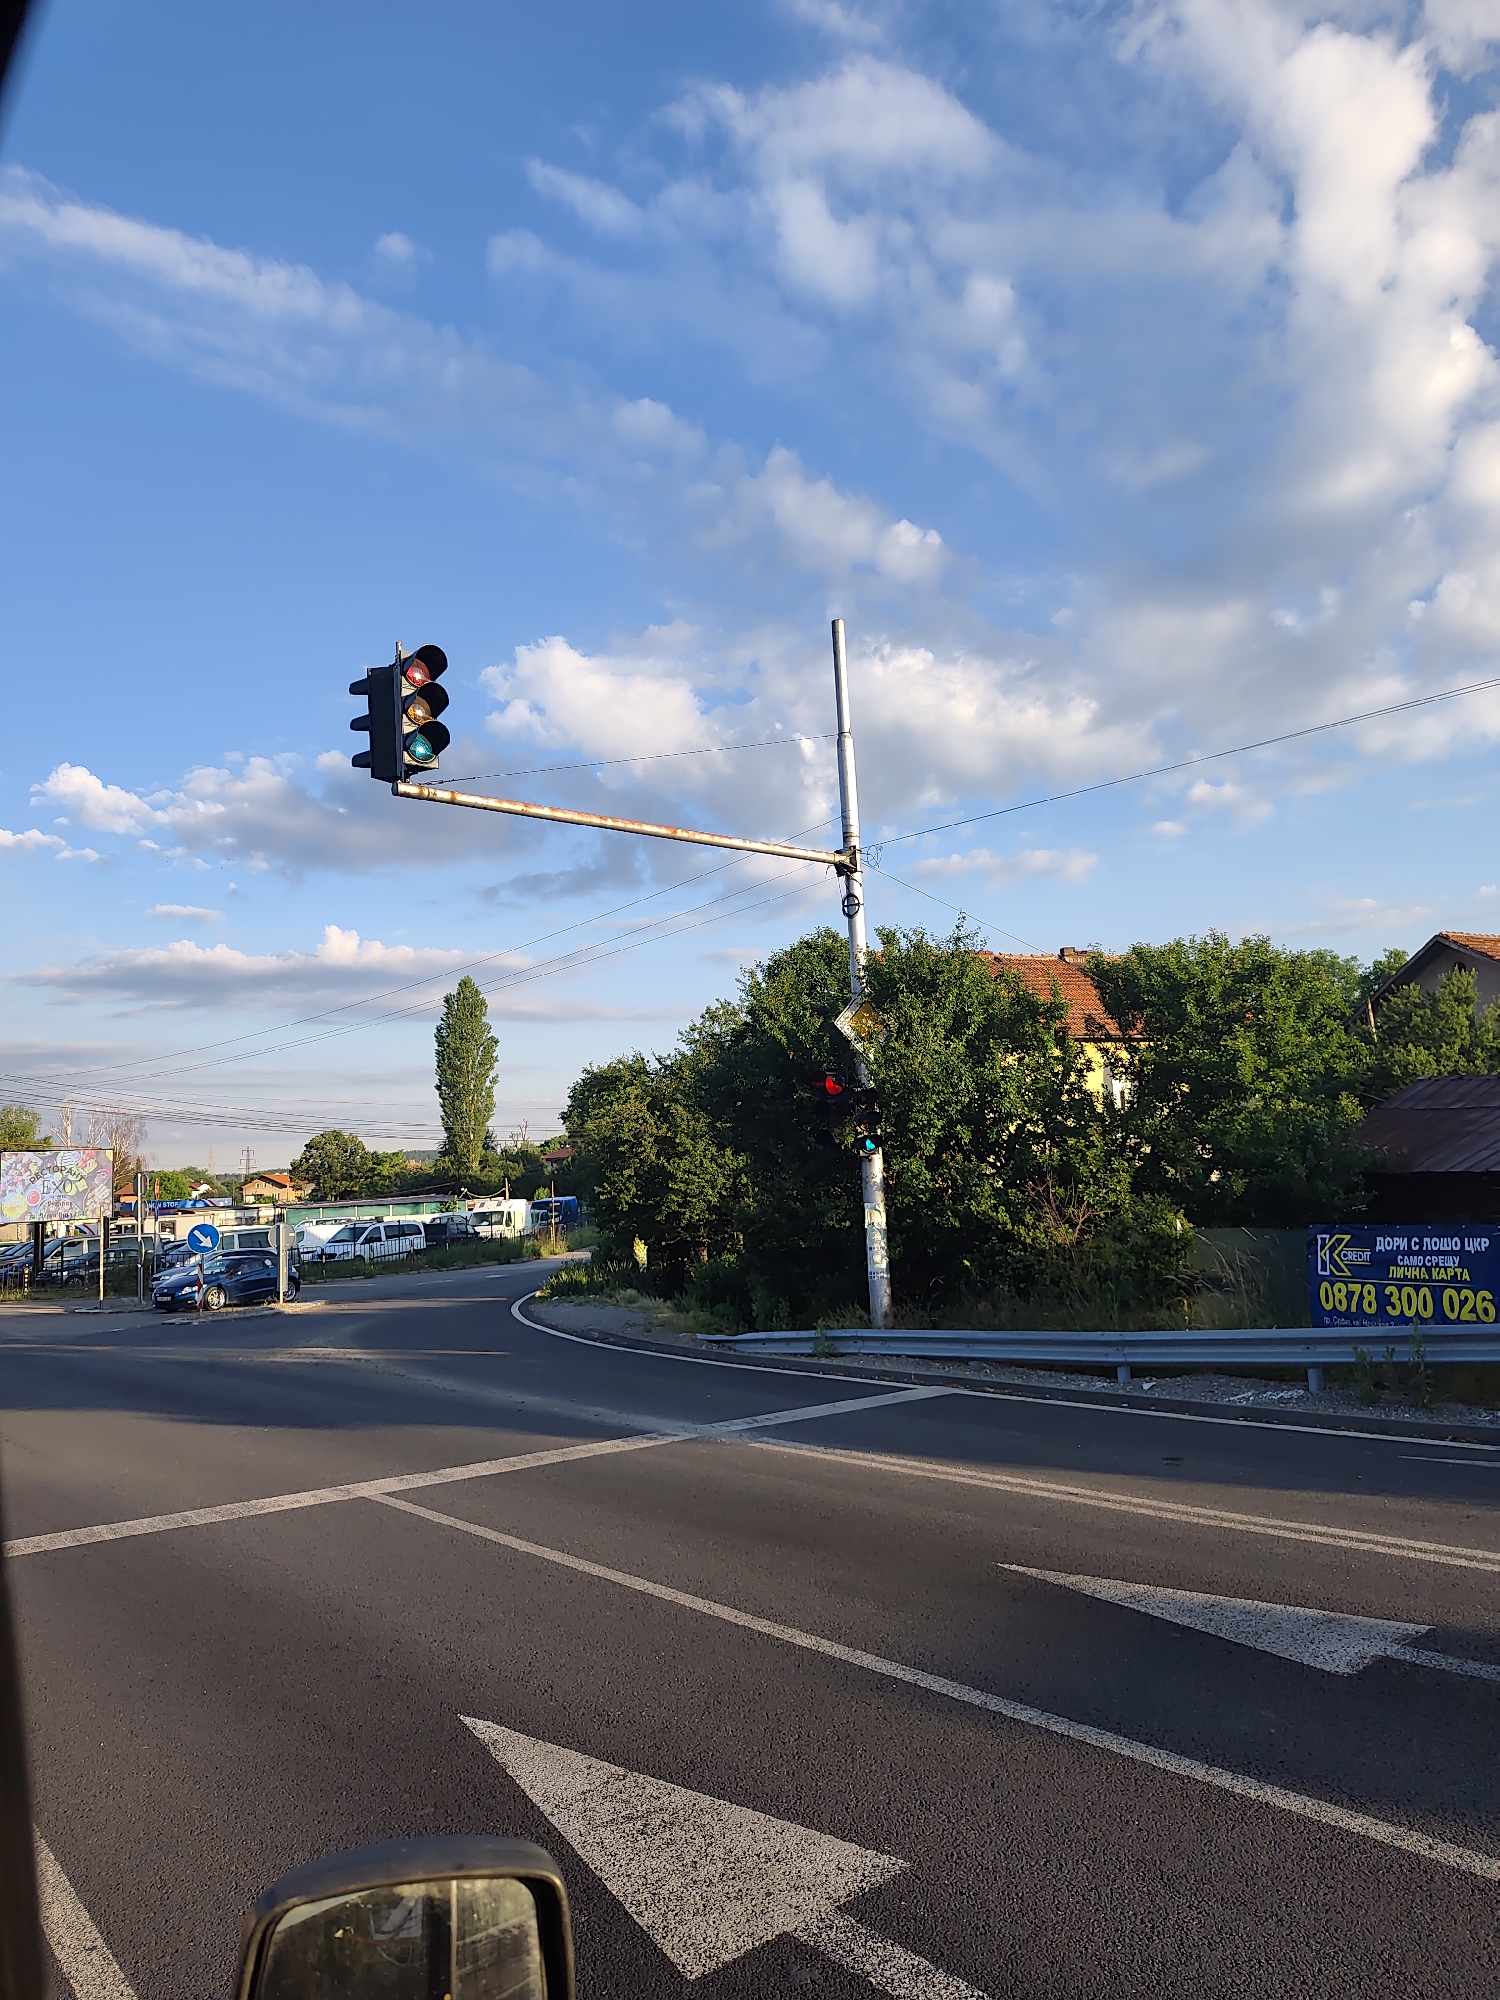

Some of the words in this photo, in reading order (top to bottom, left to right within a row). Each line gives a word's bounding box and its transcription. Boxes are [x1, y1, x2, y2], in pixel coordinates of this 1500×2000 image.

[29, 1165, 86, 1185] РЕСТОРАНТ
[1375, 1236, 1408, 1252] ДОРИ
[1411, 1237, 1420, 1251] С
[1422, 1237, 1461, 1251] ЛОШО
[1464, 1237, 1490, 1254] ЦКР
[1341, 1250, 1372, 1262] CREDIT
[1397, 1255, 1424, 1267] САМО
[1425, 1255, 1460, 1269] СРЕЩУ
[1388, 1266, 1429, 1279] ЛИЧНА
[1431, 1267, 1471, 1281] КАРТА
[1320, 1281, 1377, 1314] 0878
[1384, 1286, 1434, 1319] 300
[1442, 1288, 1496, 1323] 026
